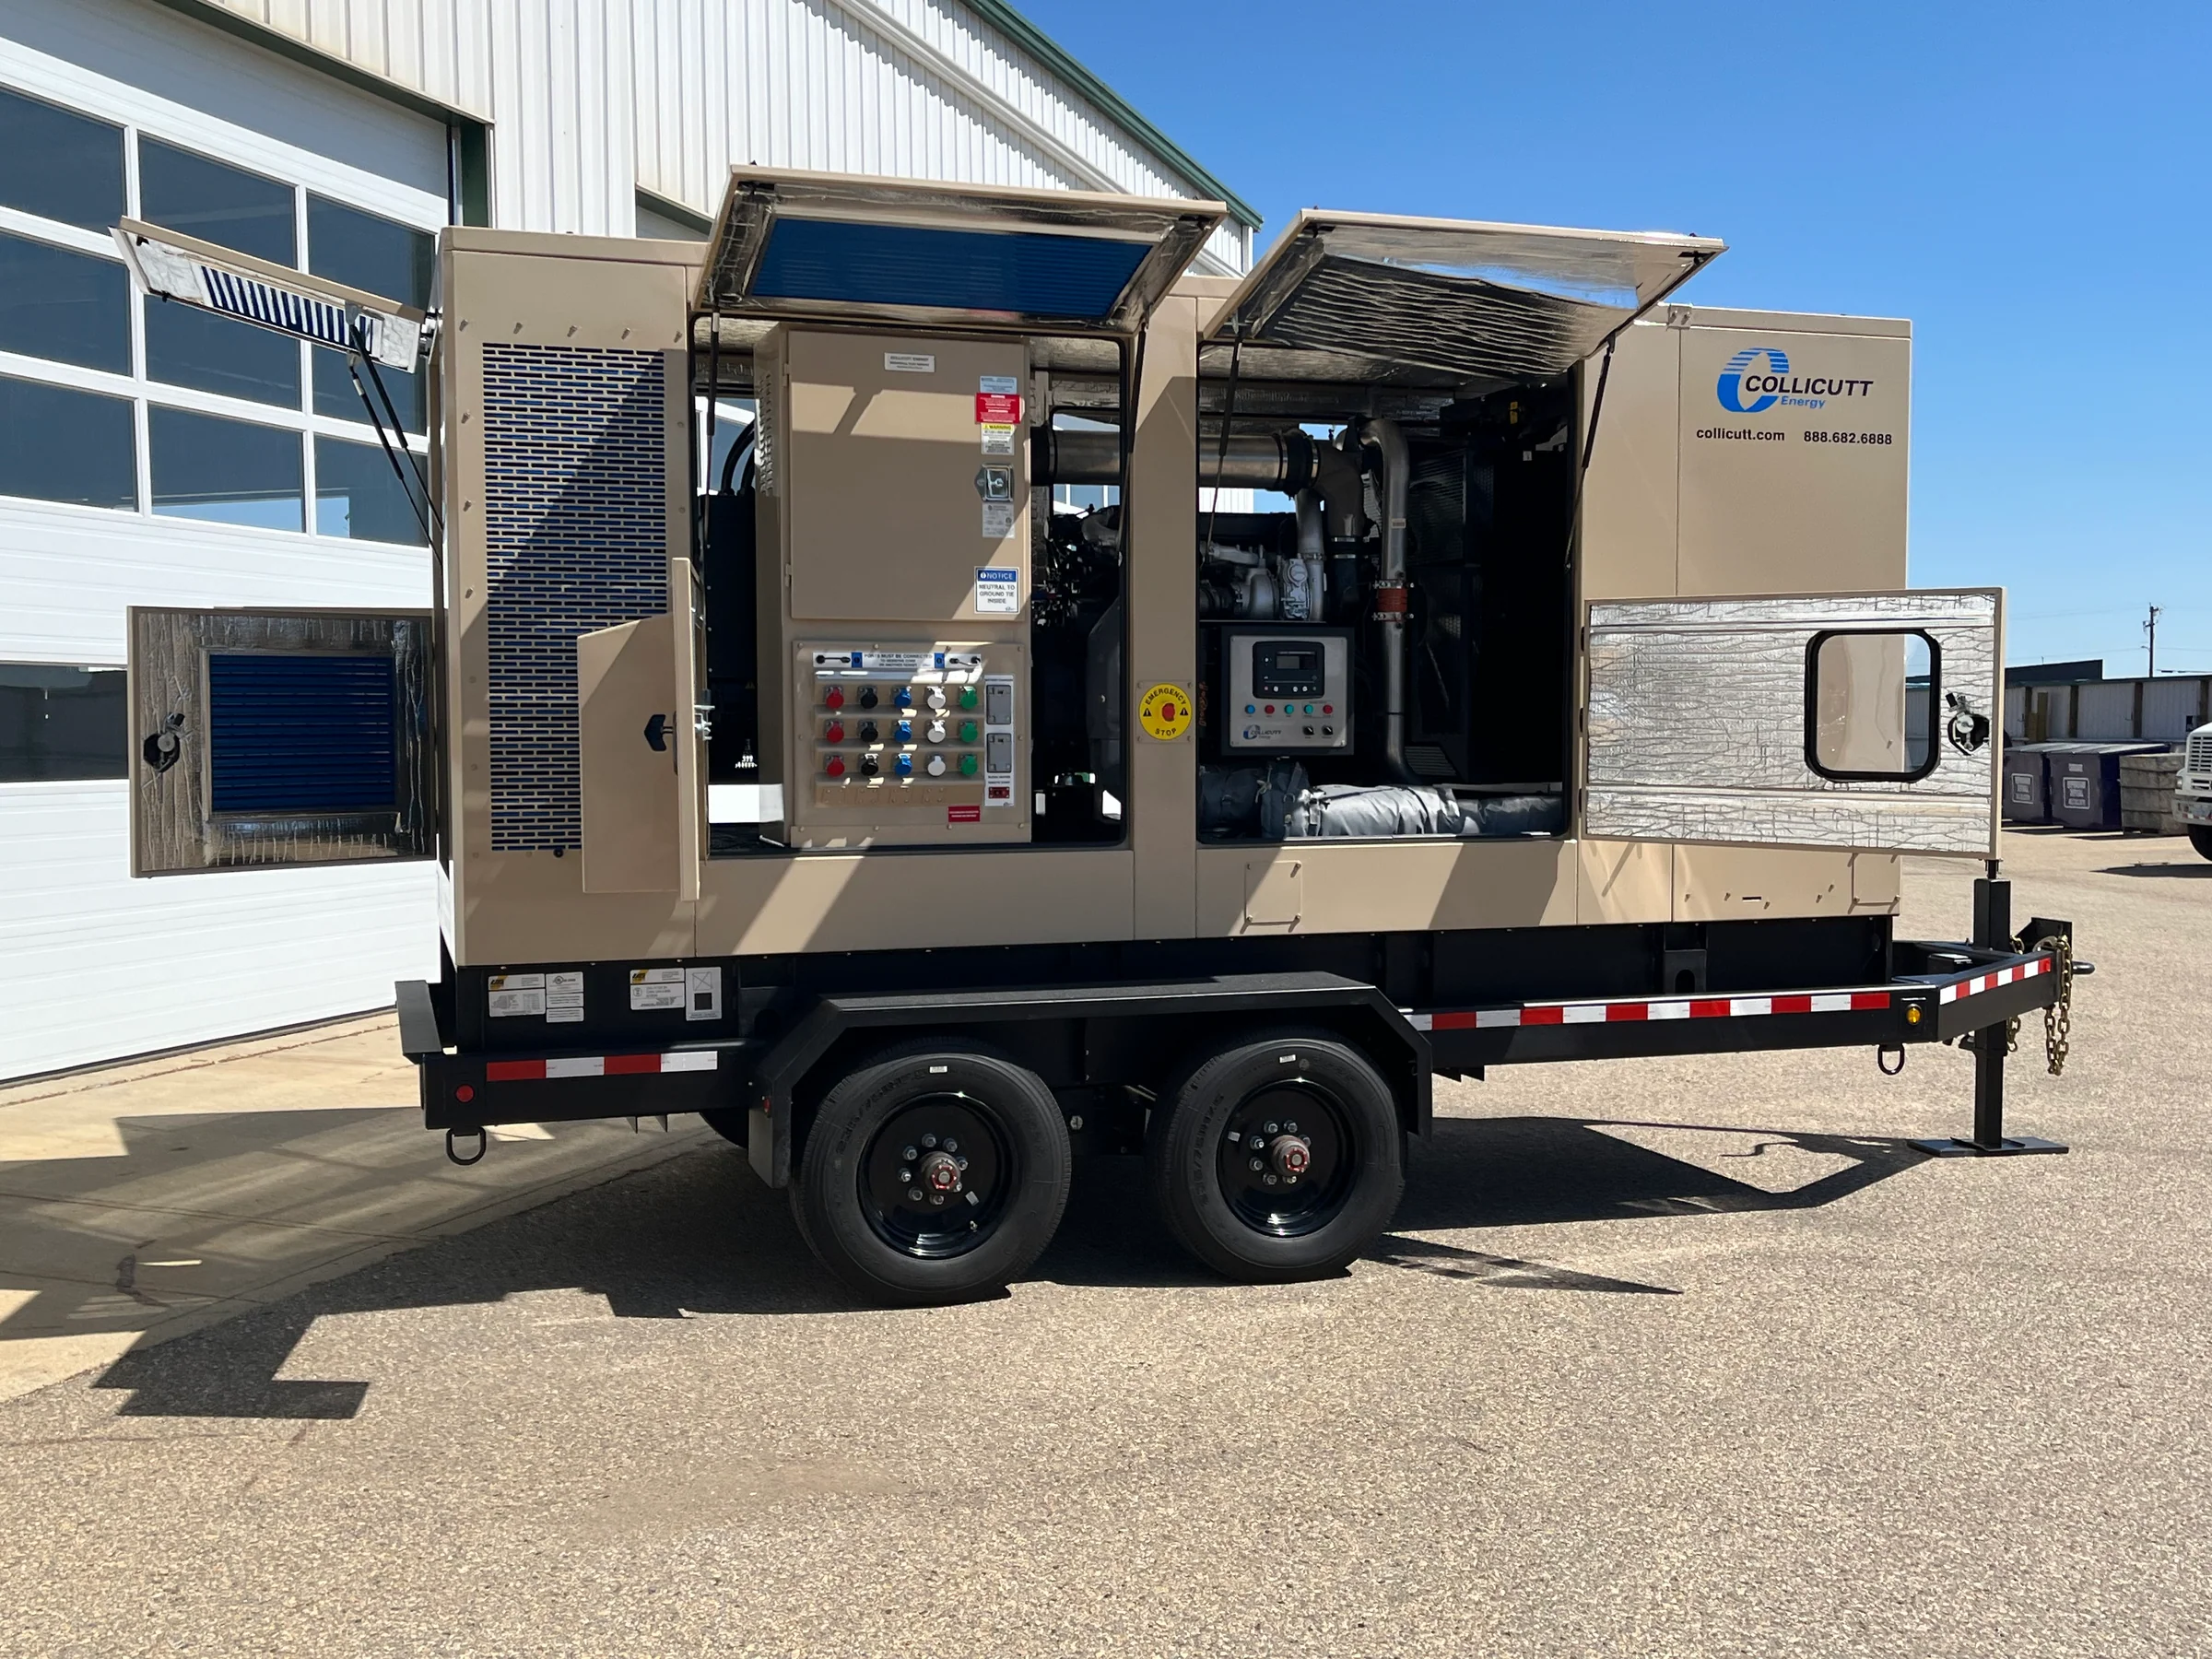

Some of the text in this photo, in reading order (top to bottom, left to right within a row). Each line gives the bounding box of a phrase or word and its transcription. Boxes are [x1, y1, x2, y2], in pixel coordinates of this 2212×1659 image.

[1746, 375, 1874, 396] COLLICUTT
[1781, 395, 1826, 409] Energy
[1696, 428, 1892, 445] collicutt.com 888.682.6888
[986, 571, 1013, 580] NOTICE
[1145, 688, 1187, 705] EMERGENCY
[1154, 727, 1177, 736] STOP
